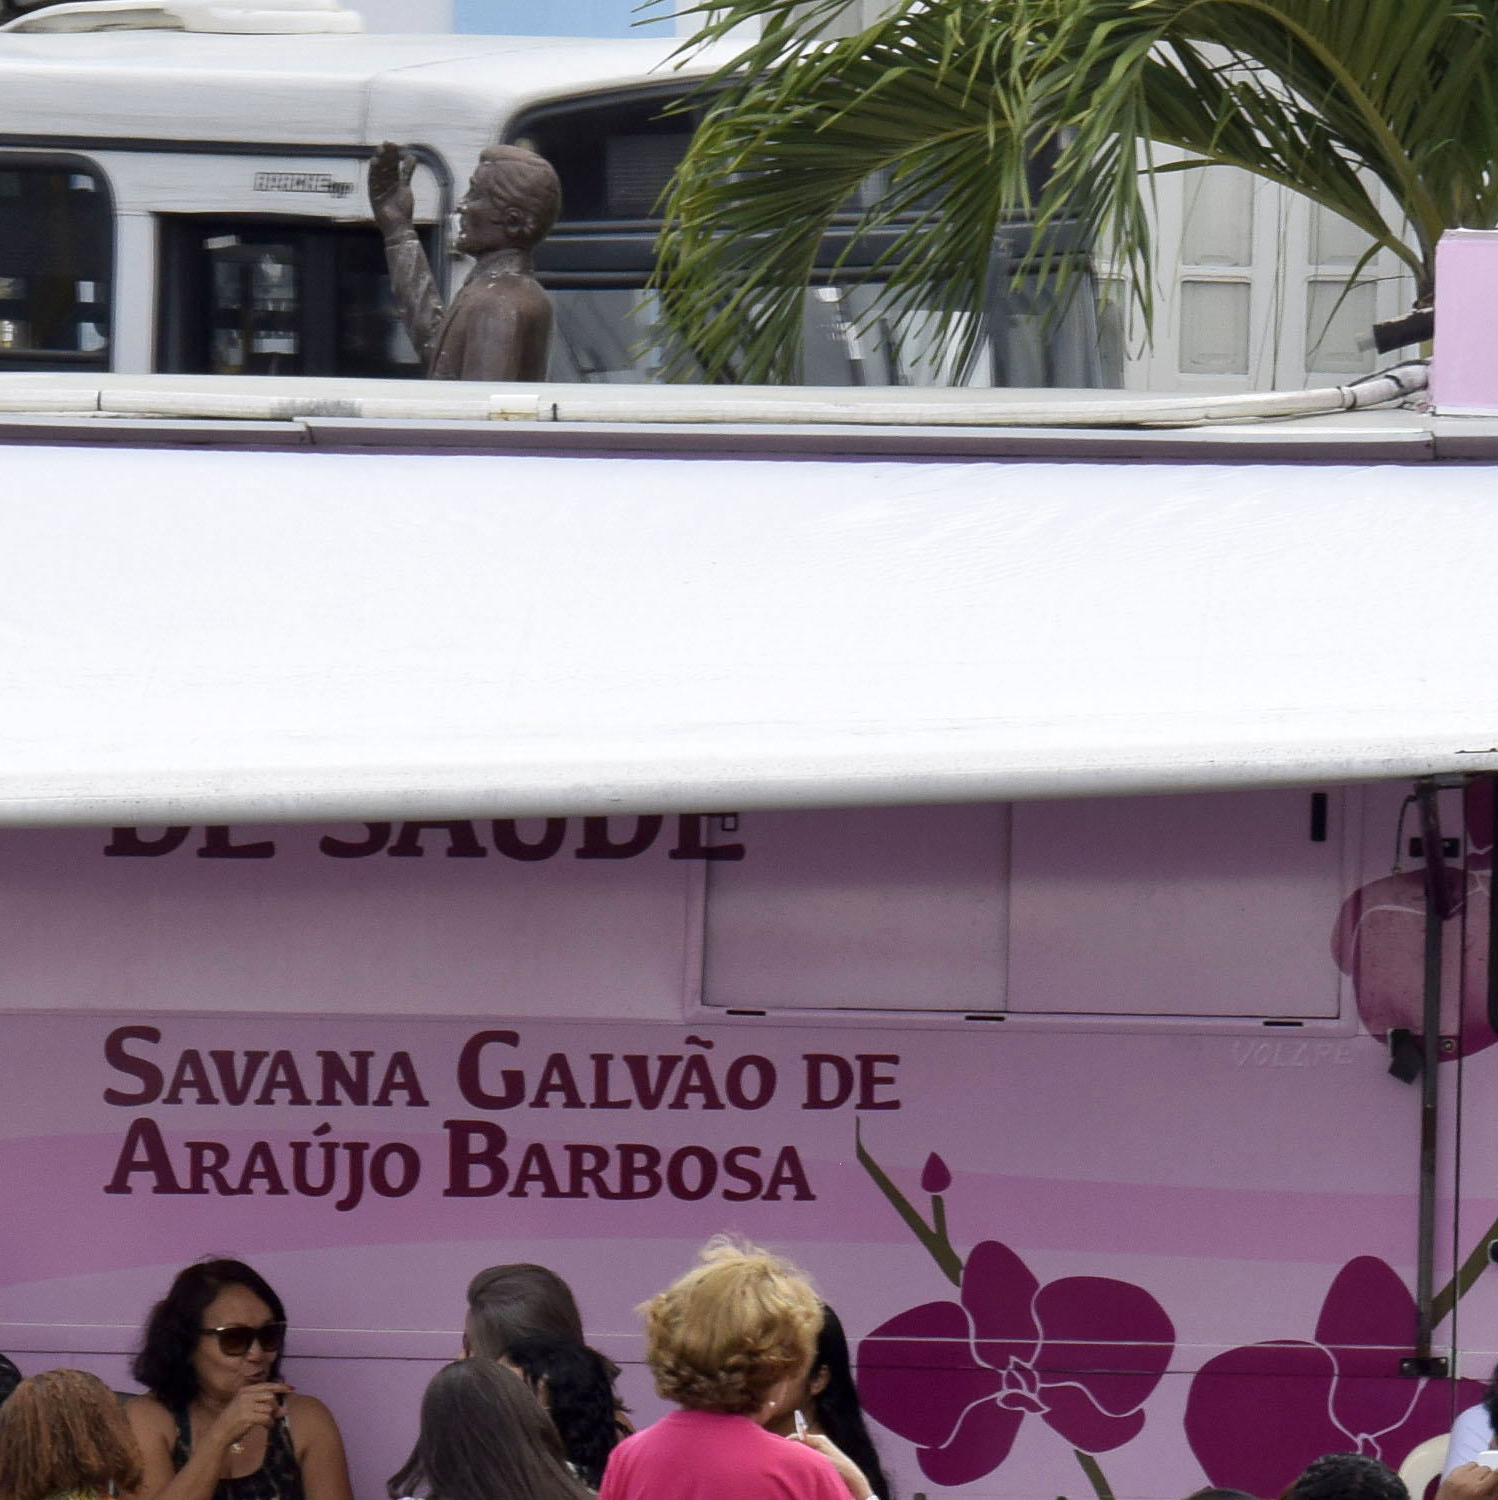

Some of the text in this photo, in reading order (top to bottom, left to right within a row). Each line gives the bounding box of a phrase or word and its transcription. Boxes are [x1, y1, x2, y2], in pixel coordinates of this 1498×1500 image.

[103, 1024, 901, 1111] SAVANA GALVÃO DE
[103, 1117, 817, 1212] ARAÚJO BARBOSA
